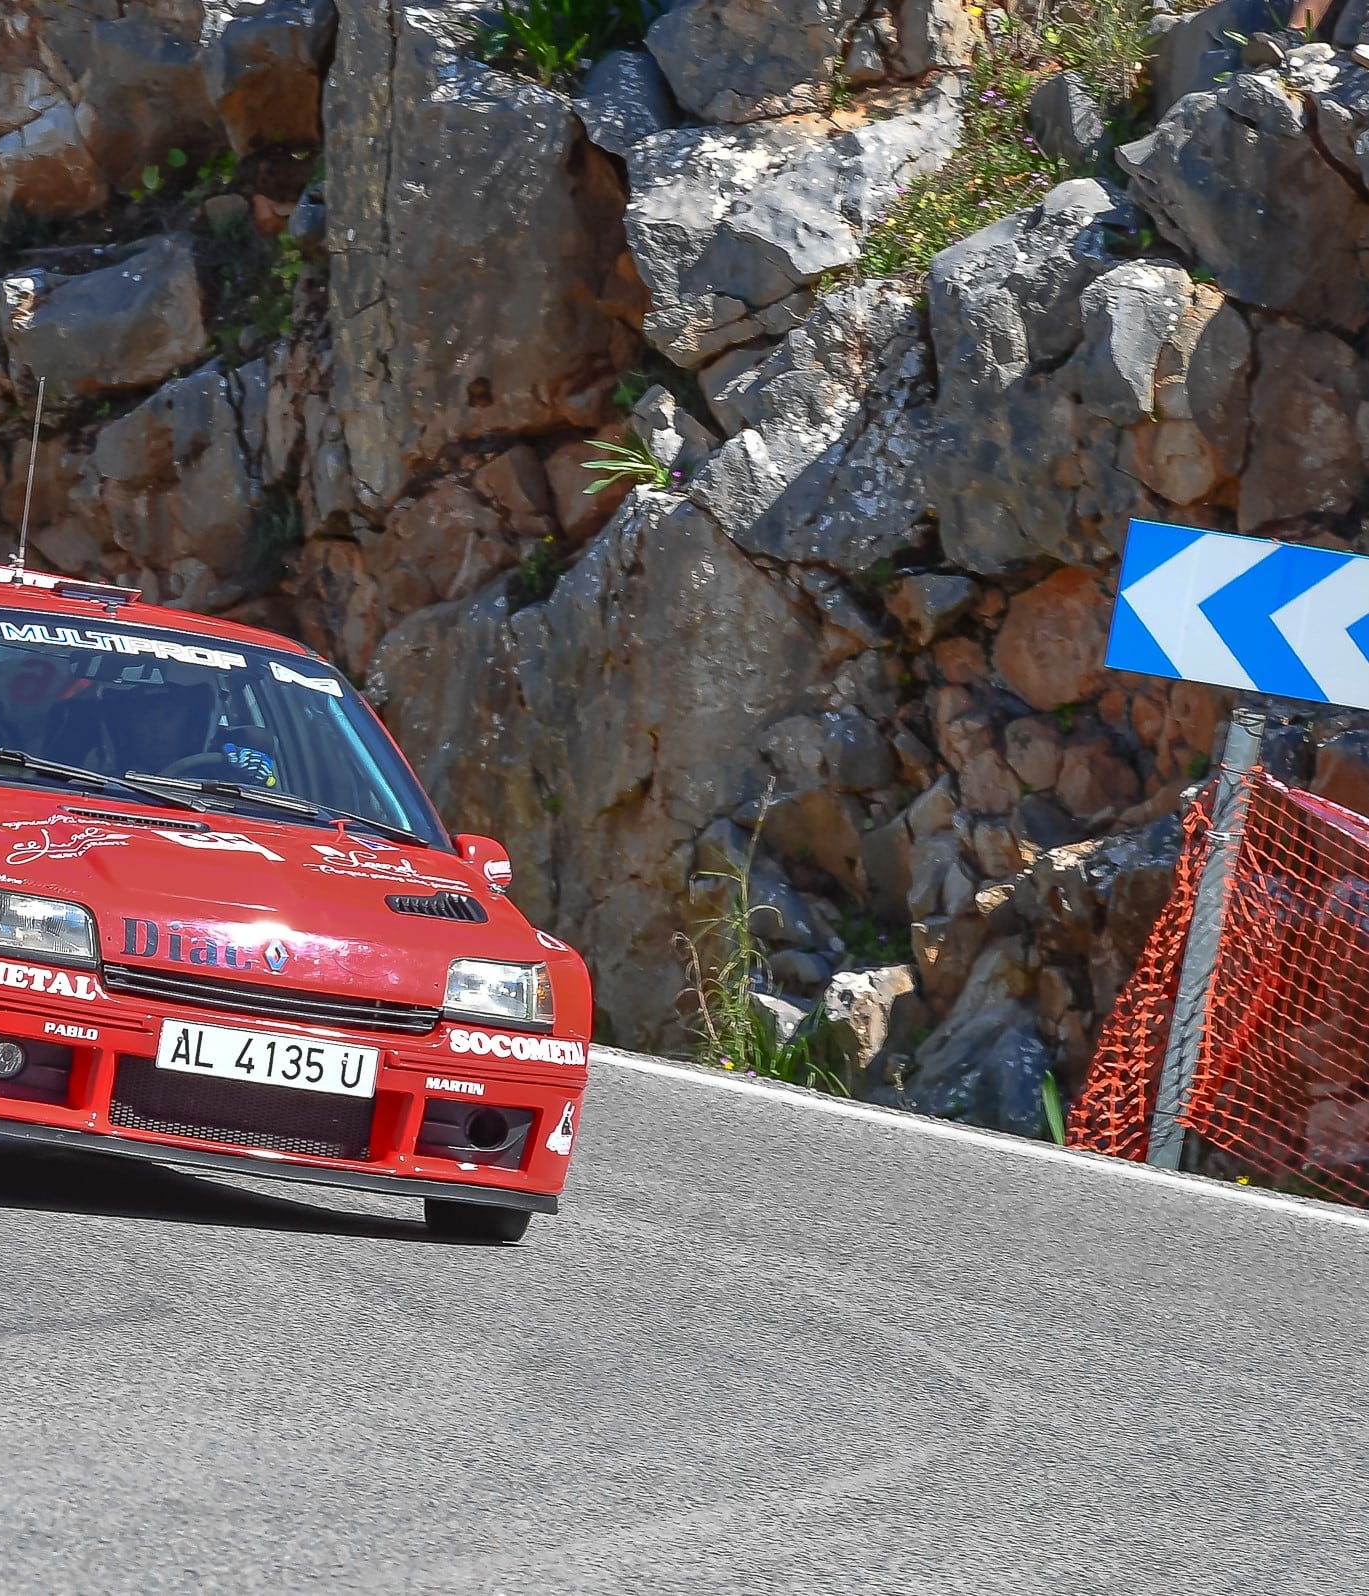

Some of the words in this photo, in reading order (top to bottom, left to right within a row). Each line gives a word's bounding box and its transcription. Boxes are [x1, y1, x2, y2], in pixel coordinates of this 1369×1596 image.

[0, 621, 247, 669] MULTIPROF
[43, 1021, 99, 1041] PABLO
[449, 1028, 586, 1066] SOCOMETAL
[171, 1028, 214, 1068] AL
[235, 1038, 325, 1083] 4135
[340, 1052, 364, 1088] U
[425, 1076, 485, 1096] MARTIN
